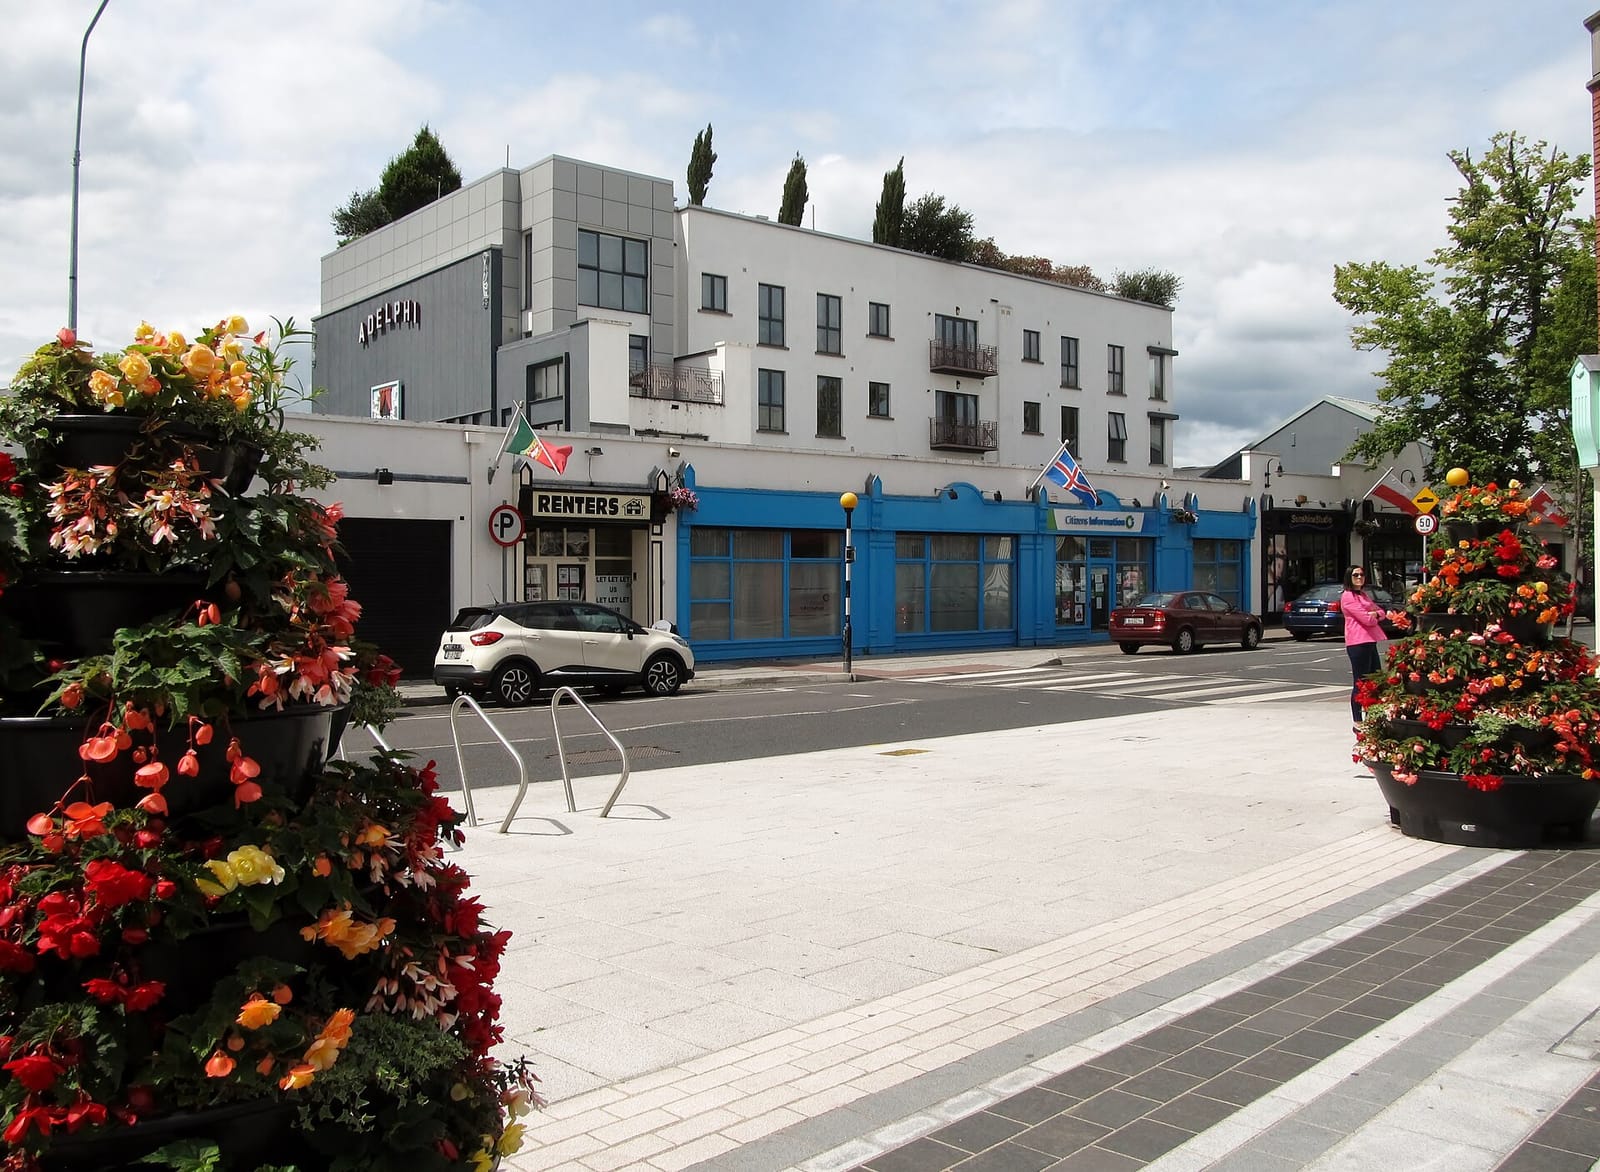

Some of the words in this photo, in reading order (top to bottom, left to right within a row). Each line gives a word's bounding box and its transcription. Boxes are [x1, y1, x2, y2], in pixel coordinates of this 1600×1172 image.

[358, 299, 419, 343] ADELPHI
[537, 494, 619, 516] RENTERS
[499, 512, 514, 538] P
[1065, 515, 1088, 525] Citizens
[1089, 516, 1125, 526] Information
[1419, 518, 1431, 527] 50
[609, 585, 617, 593] US
